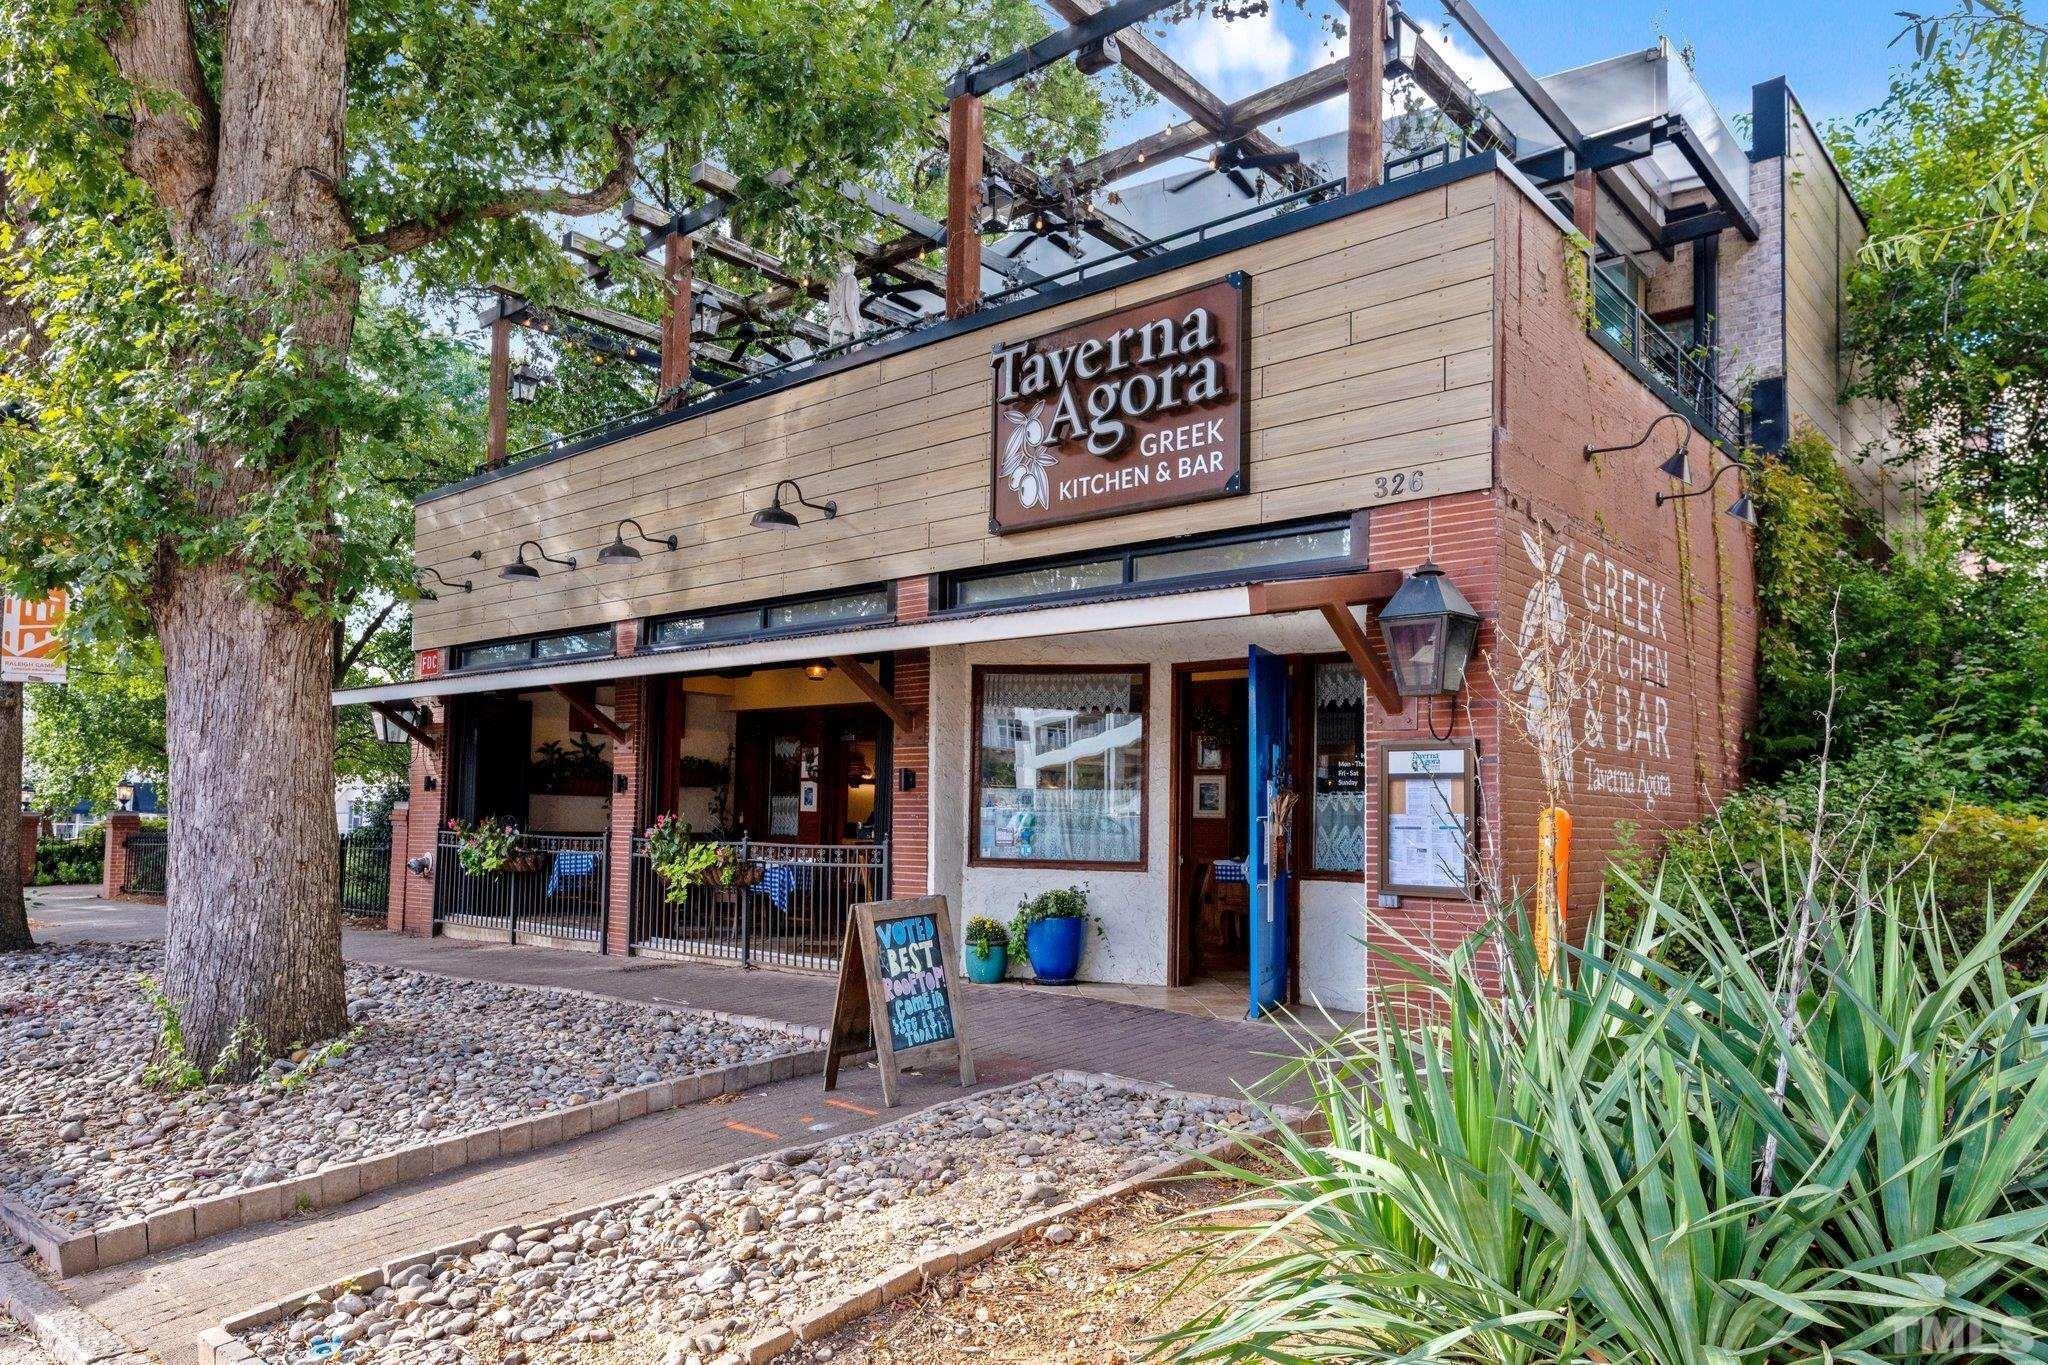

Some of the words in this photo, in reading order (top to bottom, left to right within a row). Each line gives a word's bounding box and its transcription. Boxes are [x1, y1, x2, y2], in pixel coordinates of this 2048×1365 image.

[990, 307, 1214, 402] Taverna
[1044, 357, 1223, 456] Agora
[1140, 418, 1224, 457] GREEK
[1059, 465, 1149, 501] KITCHEN
[1155, 461, 1172, 483] &
[1178, 450, 1224, 477] BAR
[1373, 470, 1424, 499] 326
[1582, 551, 1667, 642] GREEK
[422, 654, 437, 670] FDC
[1582, 620, 1668, 688] KITCHEN
[1584, 678, 1605, 749] &
[1616, 685, 1670, 759] BAR
[1338, 769, 1346, 777] Fri
[1350, 769, 1359, 777] Sat
[1338, 779, 1358, 787] Sunday
[1584, 757, 1635, 794] Taverna
[1637, 760, 1671, 813] Agora
[876, 916, 934, 949] VOTED
[887, 940, 933, 978] BEST
[882, 965, 946, 1003] ROOFTOP!
